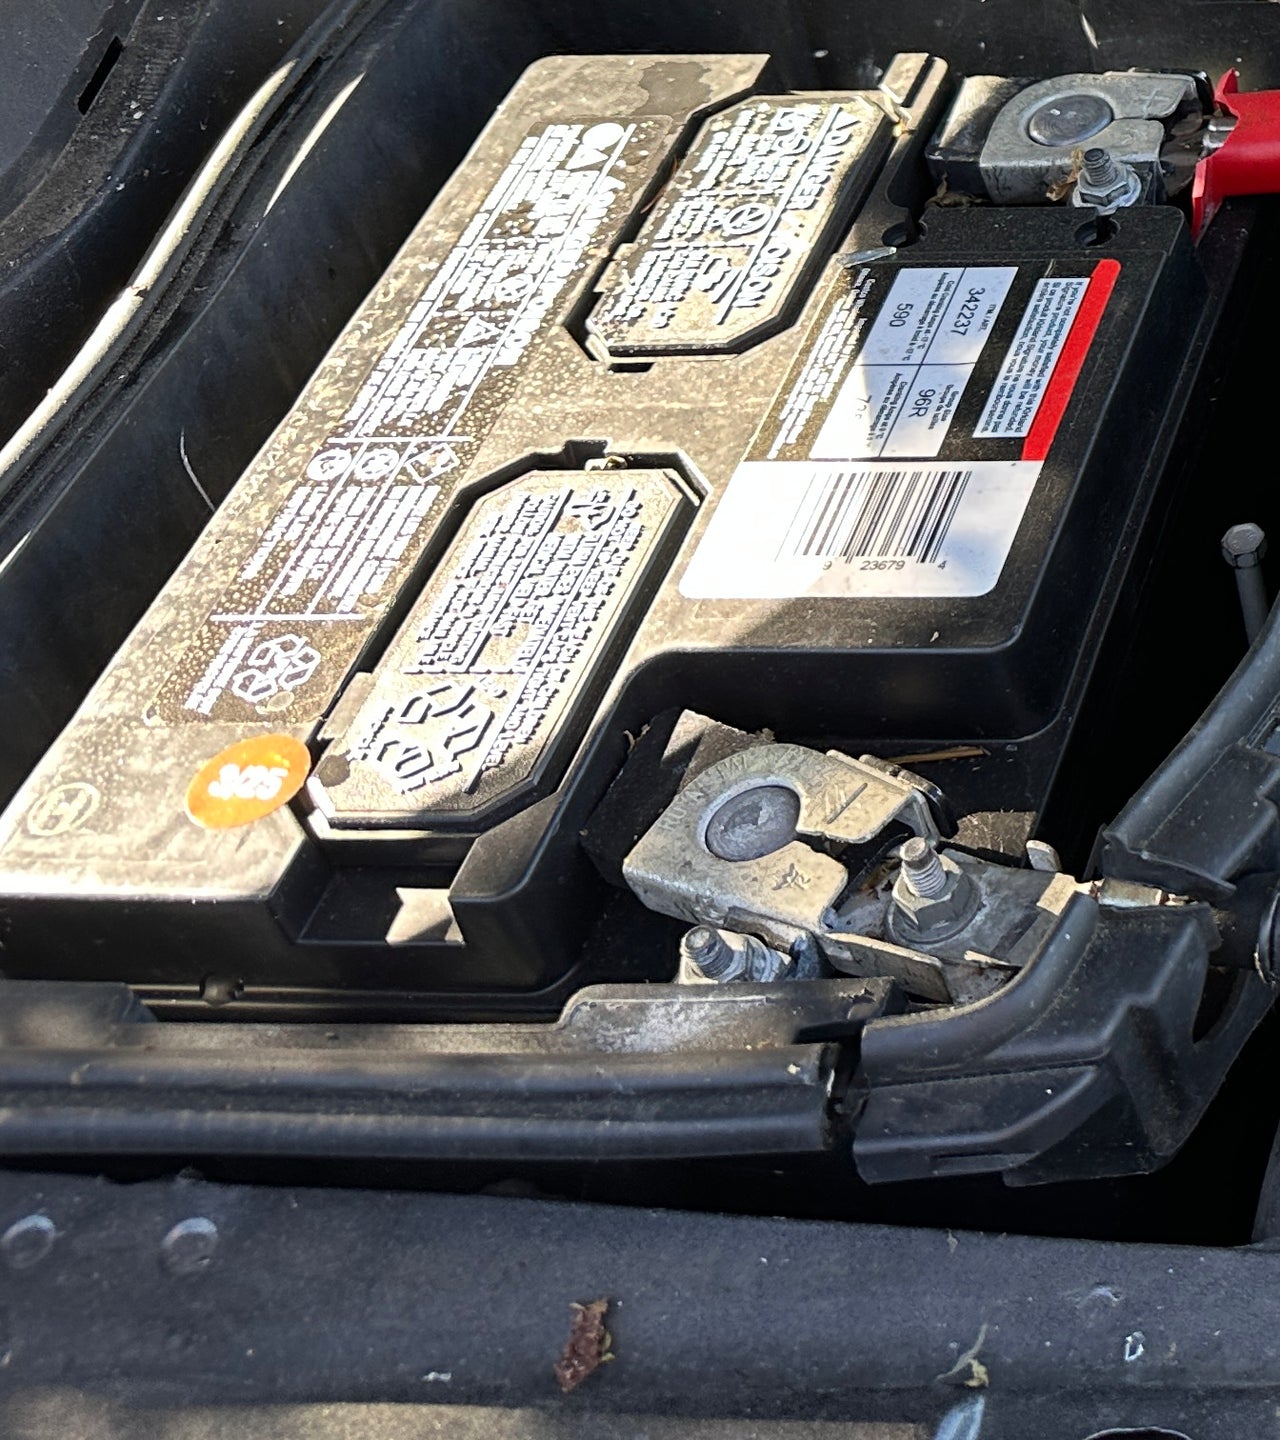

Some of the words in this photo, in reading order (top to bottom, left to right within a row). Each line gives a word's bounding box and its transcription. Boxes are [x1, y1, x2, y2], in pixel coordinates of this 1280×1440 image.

[887, 303, 914, 326] 590
[948, 287, 986, 335] 342237
[907, 389, 936, 417] 96R
[859, 560, 906, 571] 23679
